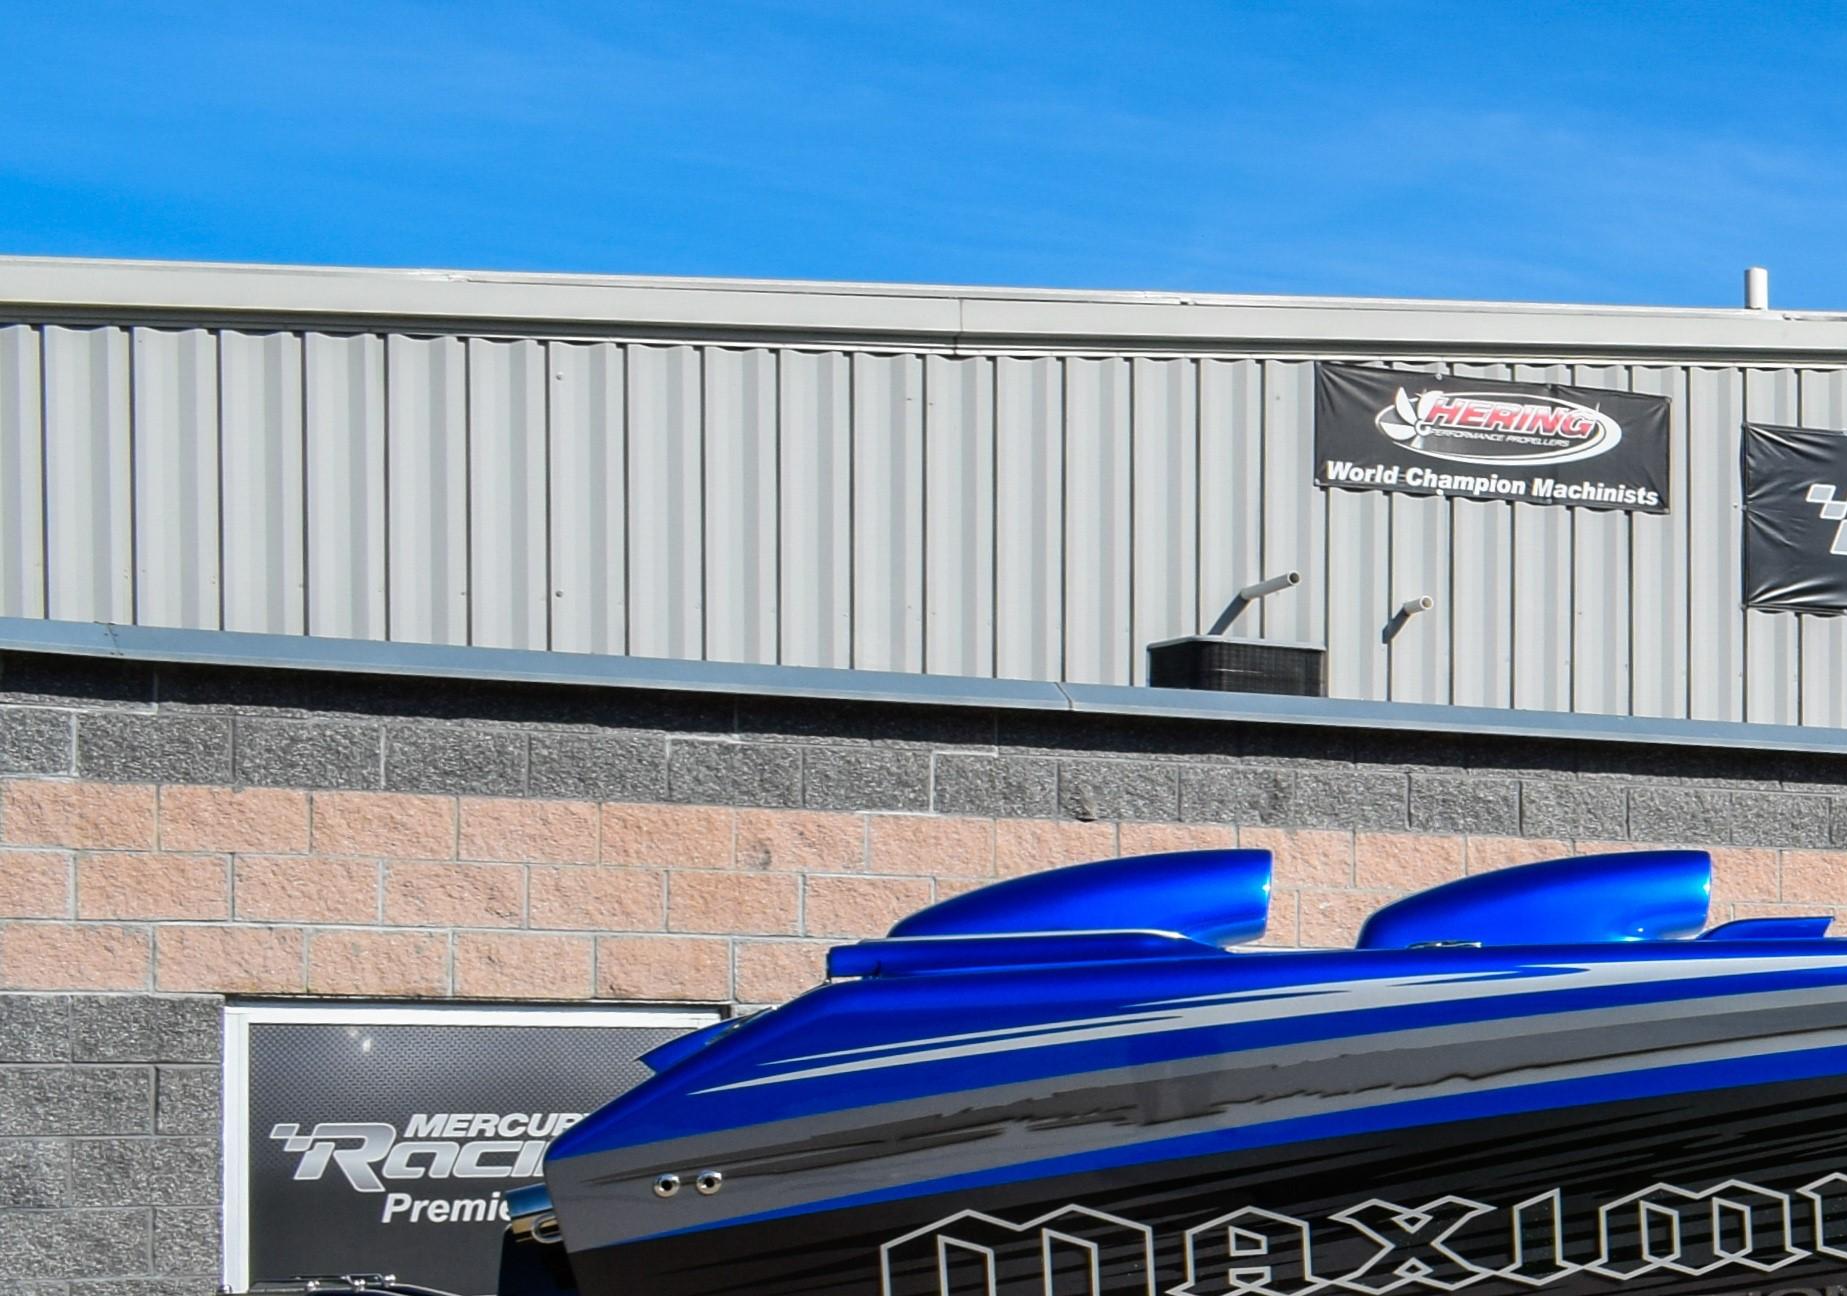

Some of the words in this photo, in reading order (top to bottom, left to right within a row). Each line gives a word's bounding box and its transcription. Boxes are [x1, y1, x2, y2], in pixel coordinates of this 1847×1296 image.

[1425, 397, 1600, 439] HERING
[1429, 427, 1505, 442] PERFORMANCE
[1505, 435, 1570, 448] PROPELLERS
[1326, 460, 1398, 486] World
[1405, 466, 1526, 498] Champion
[1532, 478, 1659, 507] Machinists
[403, 1113, 592, 1138] MERCUR
[269, 1122, 552, 1192] Raci
